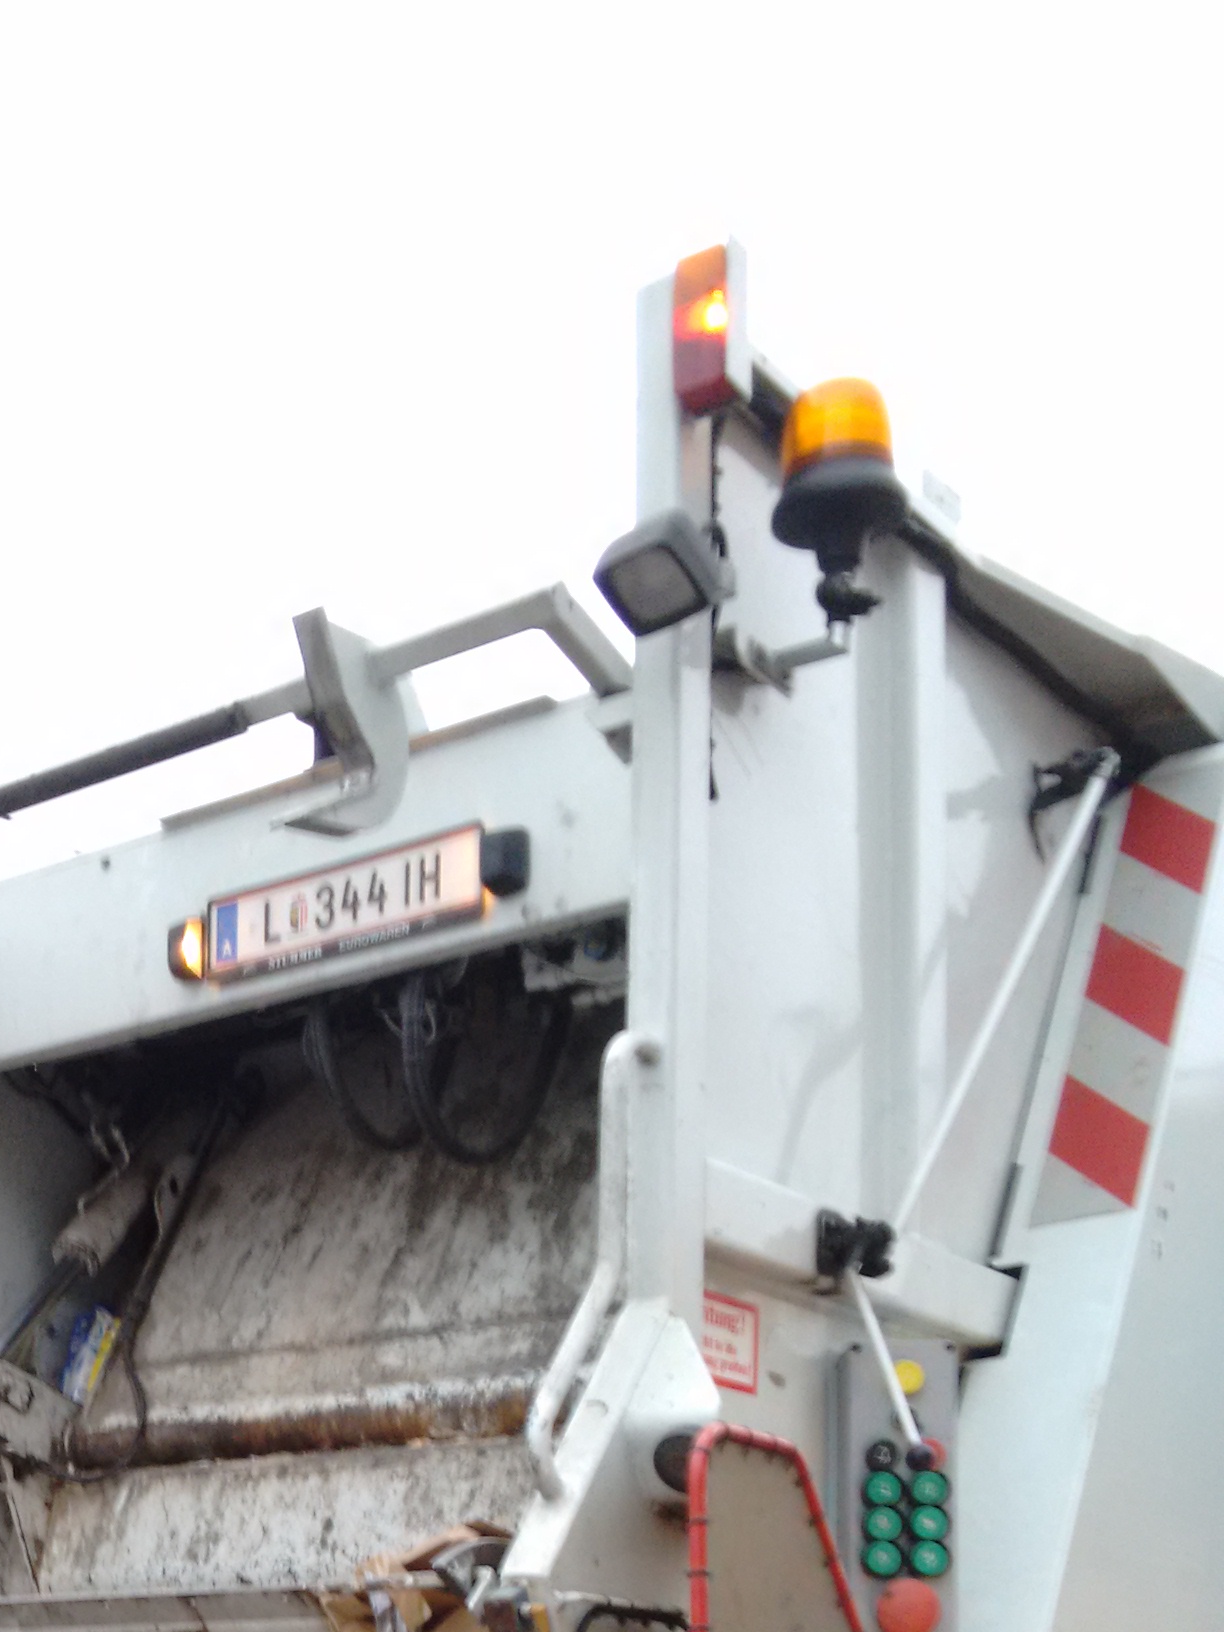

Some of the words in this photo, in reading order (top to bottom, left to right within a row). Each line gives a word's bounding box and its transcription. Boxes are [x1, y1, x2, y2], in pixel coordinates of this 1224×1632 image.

[263, 900, 282, 945] L
[316, 870, 386, 929] 344
[403, 852, 441, 907] IH
[267, 948, 323, 971] STUMMER
[338, 922, 410, 953] EUROWAREN
